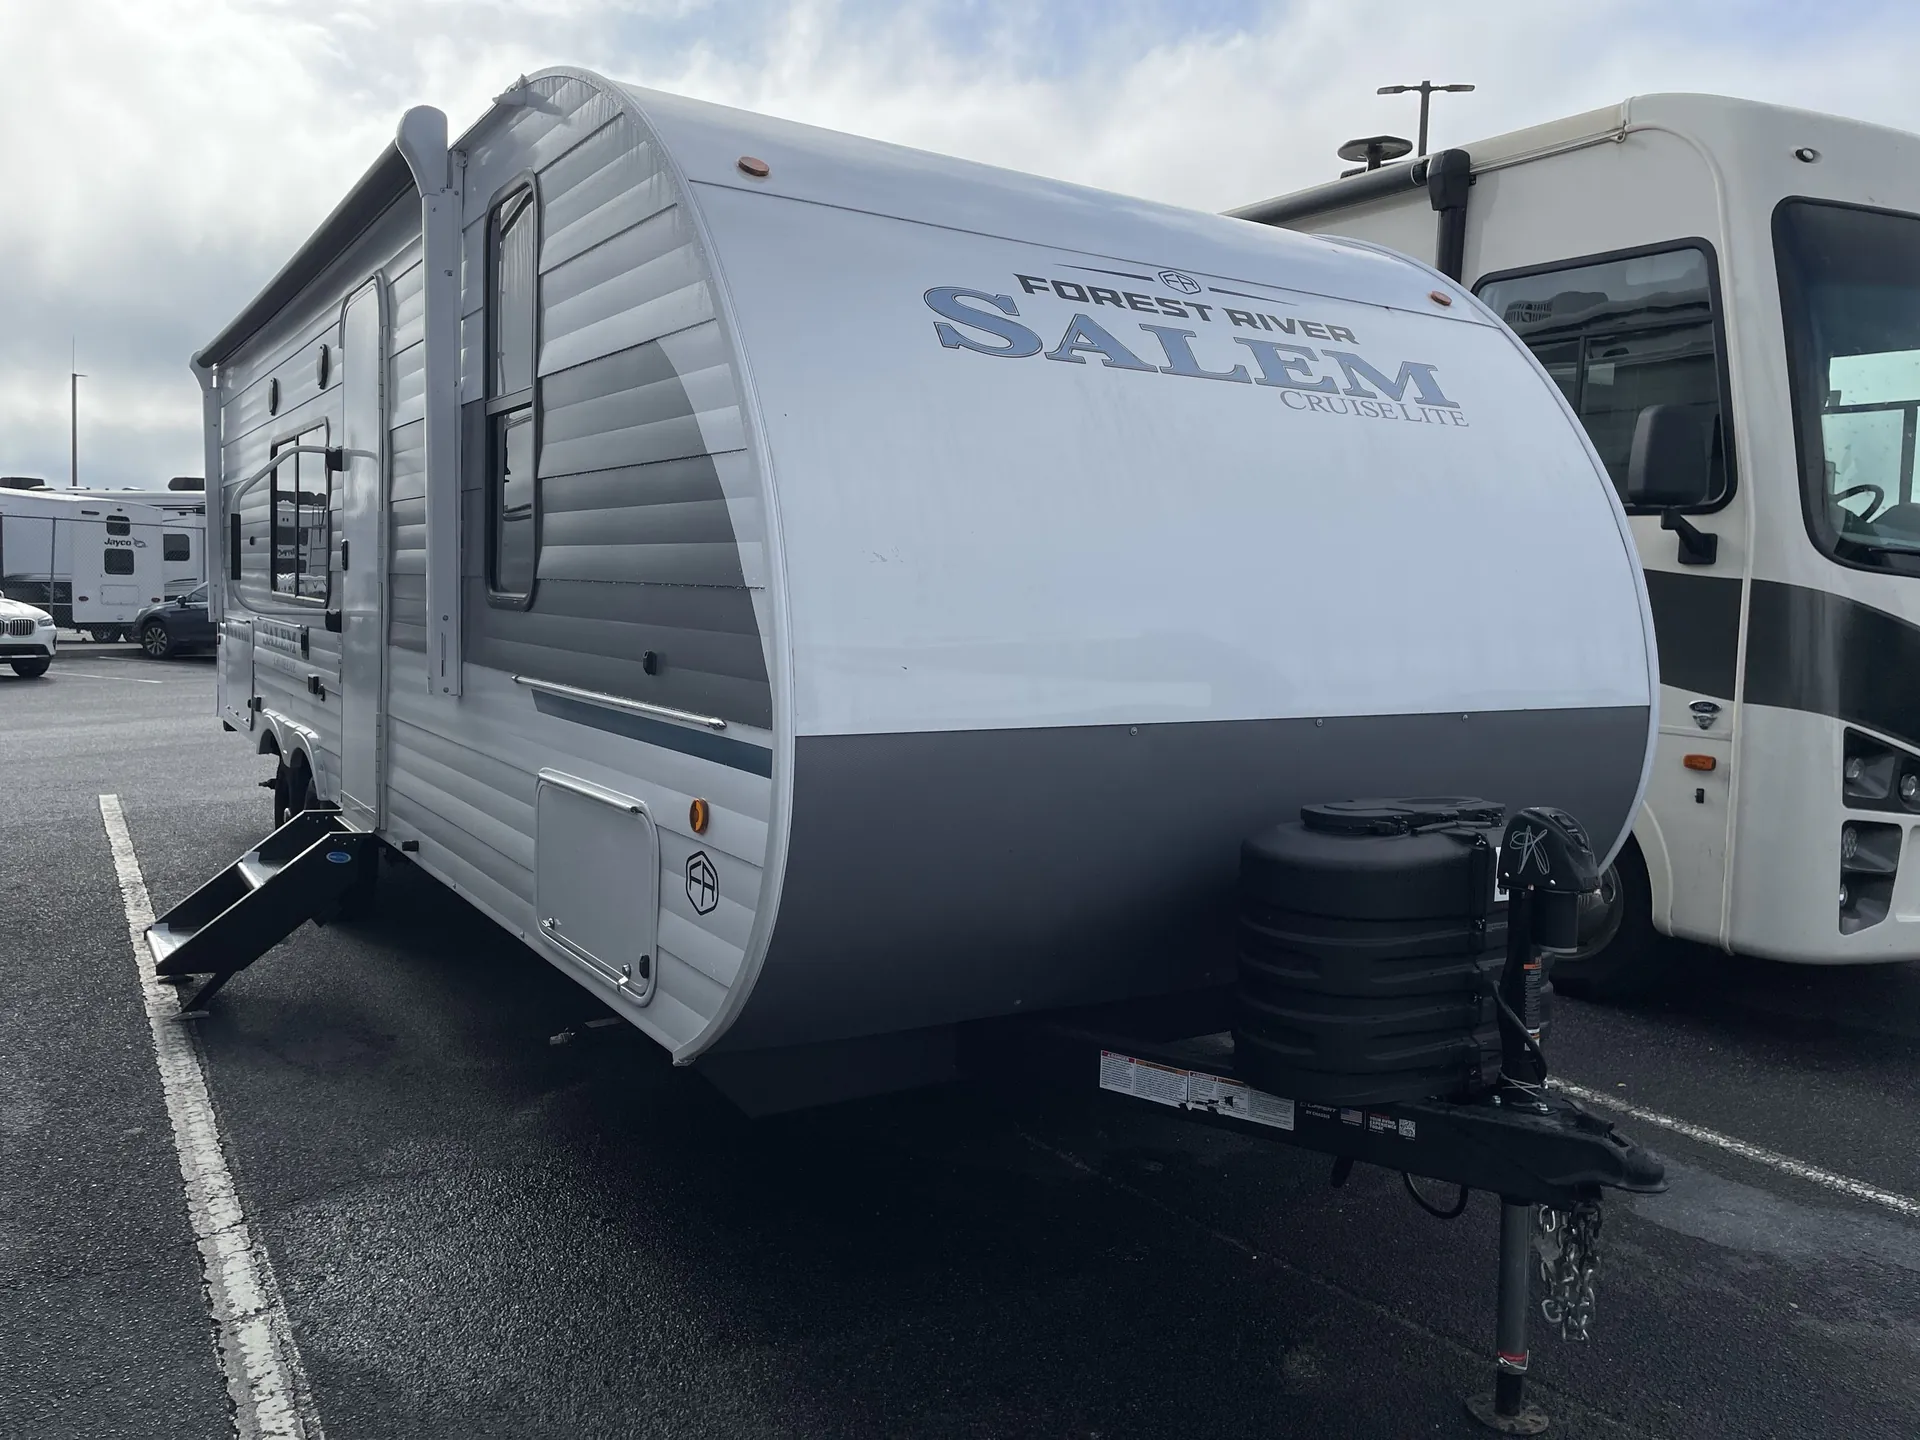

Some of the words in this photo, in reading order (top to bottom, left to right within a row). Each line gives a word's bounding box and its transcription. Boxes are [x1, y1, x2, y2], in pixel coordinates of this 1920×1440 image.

[1013, 273, 1212, 321] FOREST
[1222, 307, 1360, 345] RIVER
[923, 286, 1461, 409] SALEM
[1280, 390, 1399, 420] CRUISE
[1397, 403, 1469, 427] LITE
[104, 537, 132, 547] Jayco
